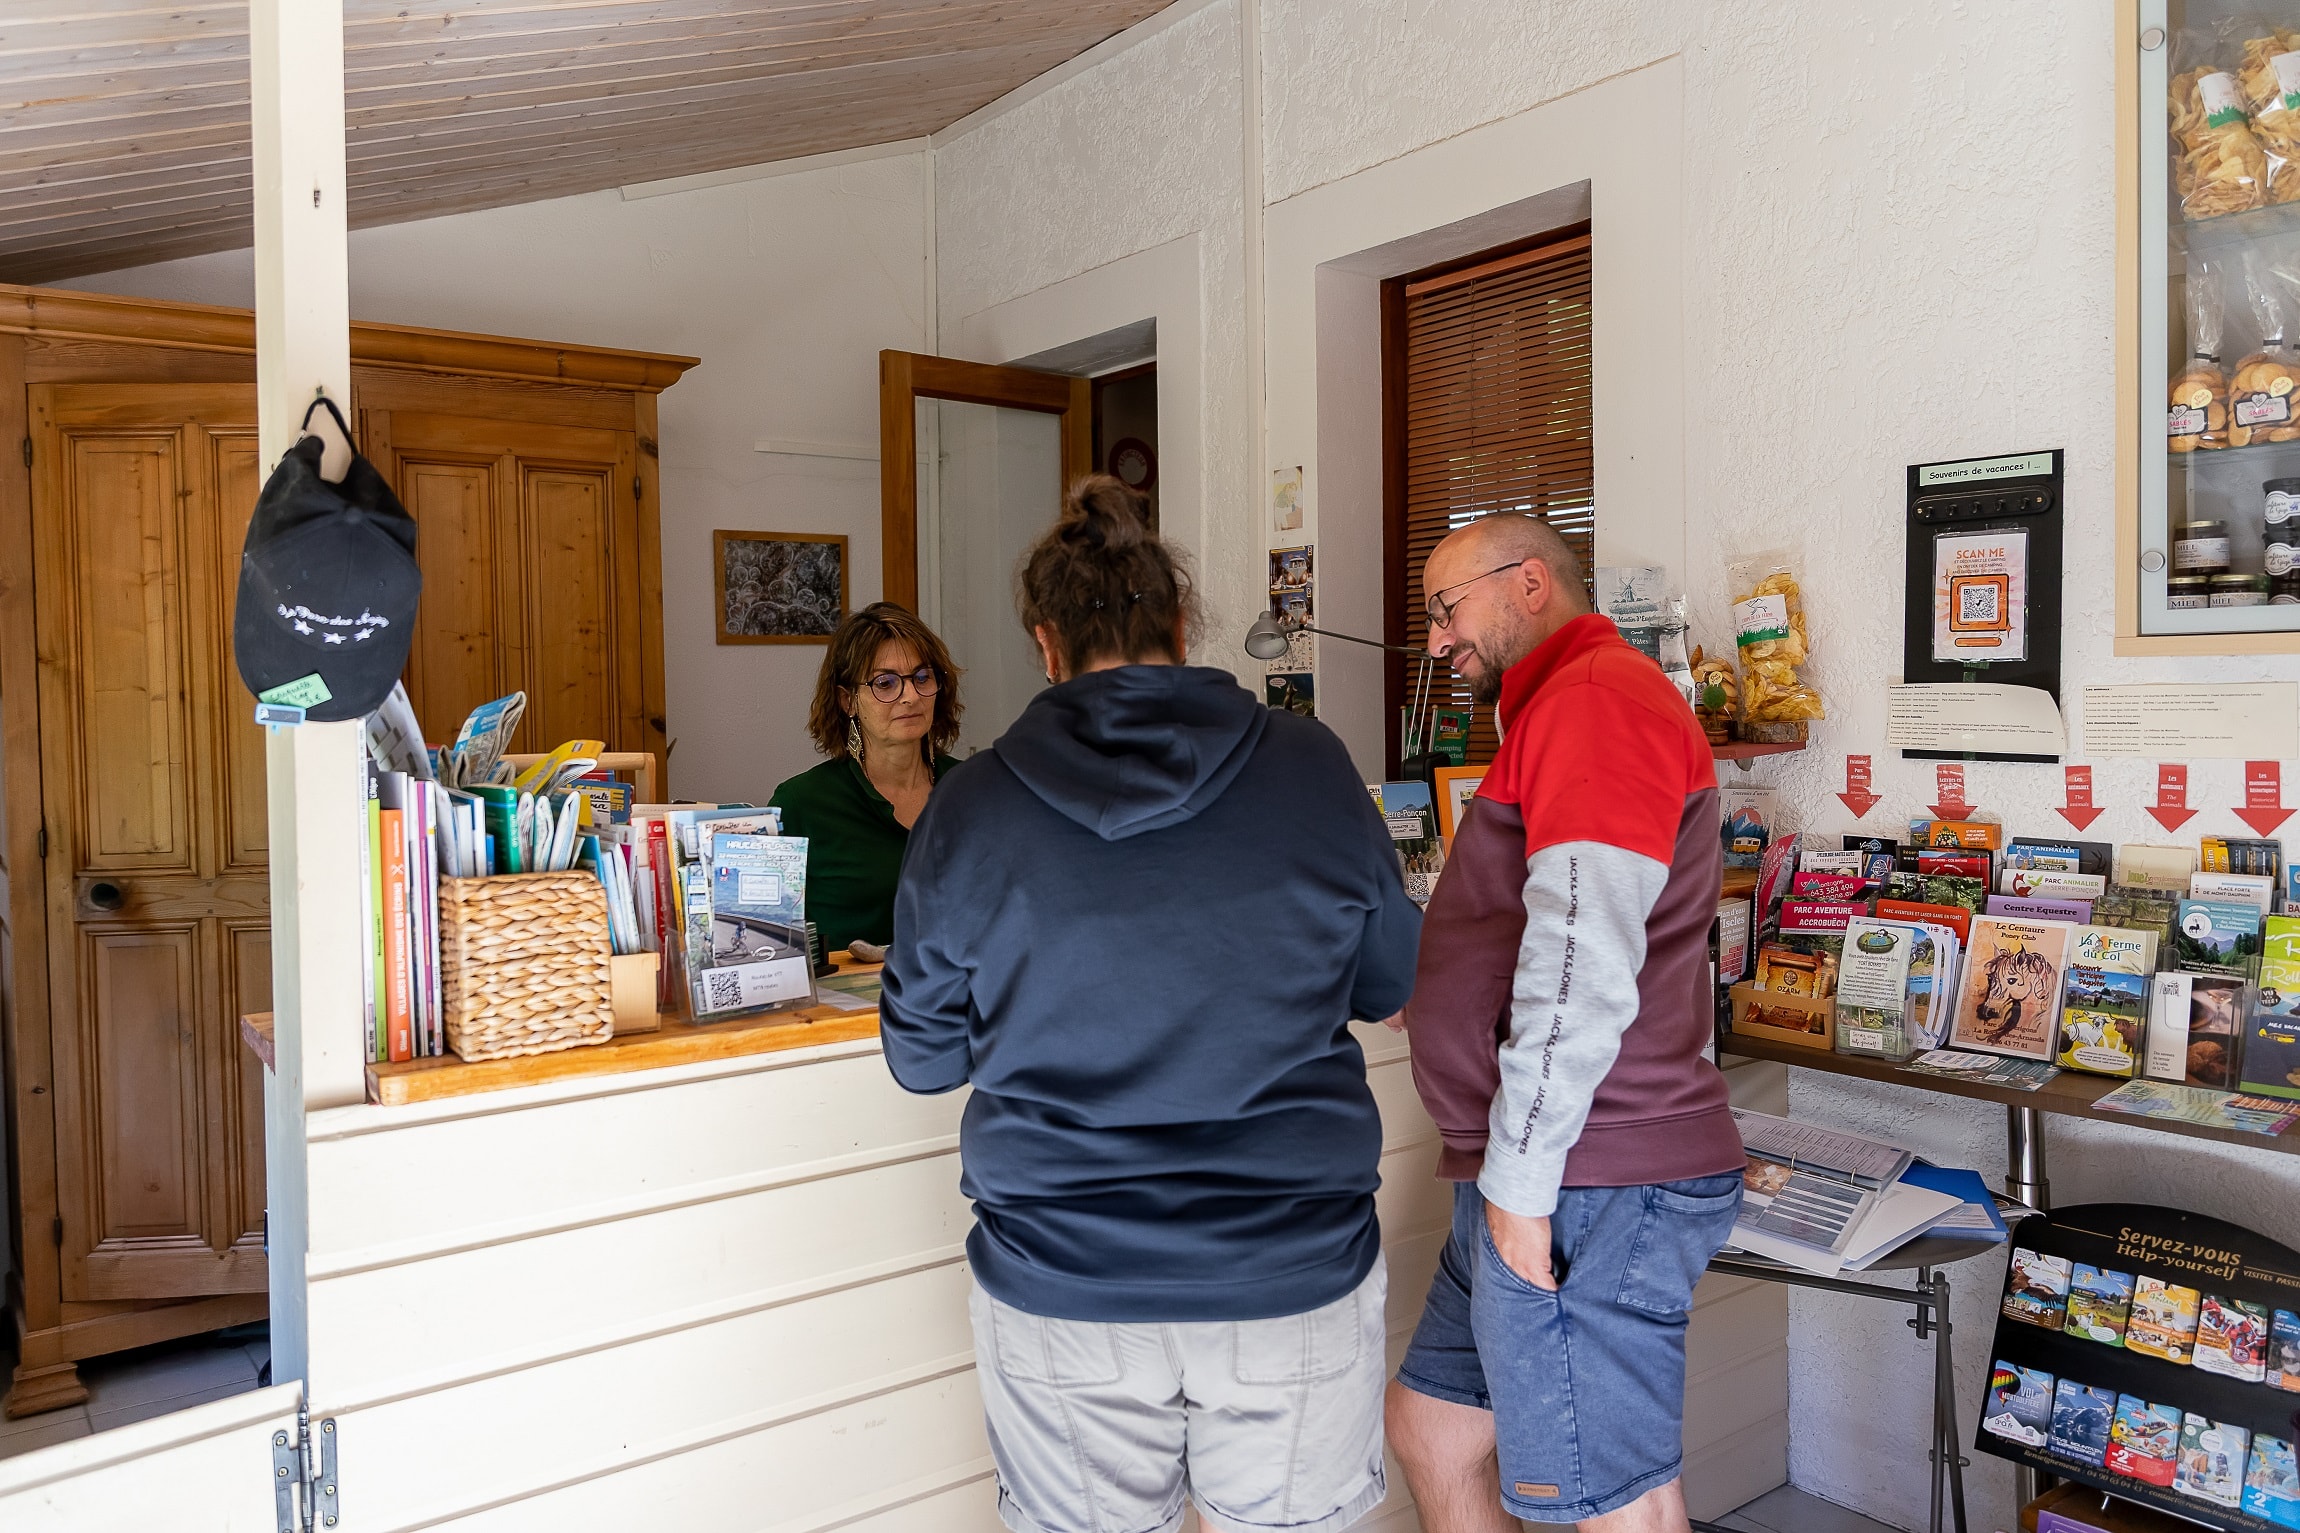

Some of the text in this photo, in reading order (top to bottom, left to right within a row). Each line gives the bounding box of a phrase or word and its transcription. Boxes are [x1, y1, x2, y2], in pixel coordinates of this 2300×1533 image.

[1929, 469, 1968, 480] Souvenirs
[1971, 467, 1982, 475] de
[1985, 462, 2024, 473] vacances
[1956, 548, 2004, 560] SCAN ME
[1384, 810, 1427, 819] Serre-Ponçon
[2035, 846, 2075, 854] ANIMALIER
[2063, 879, 2099, 887] ANIMALIER
[1566, 855, 1578, 926] JACK&JONES
[1825, 887, 1839, 895] 384
[2051, 885, 2099, 895] SERRE-PONÇON
[1793, 906, 1853, 915] PARC AVENTURE
[2004, 904, 2078, 916] Centre Equestre
[1950, 913, 1963, 921] FORÊT
[2008, 924, 2046, 934] Centaure
[2001, 932, 2020, 940] Poney
[2080, 936, 2141, 950] La Ferme
[2083, 949, 2121, 961] du Col
[1556, 933, 1575, 1005] JACK&JONES
[2072, 962, 2102, 972] Découvrir
[2076, 972, 2106, 981] Participer
[2078, 979, 2106, 989] Déguster
[2118, 1227, 2242, 1266] Servez-vous
[2116, 1243, 2239, 1281] Help-yourself
[2243, 1270, 2273, 1282] VISITES
[2021, 1386, 2035, 1399] VOL
